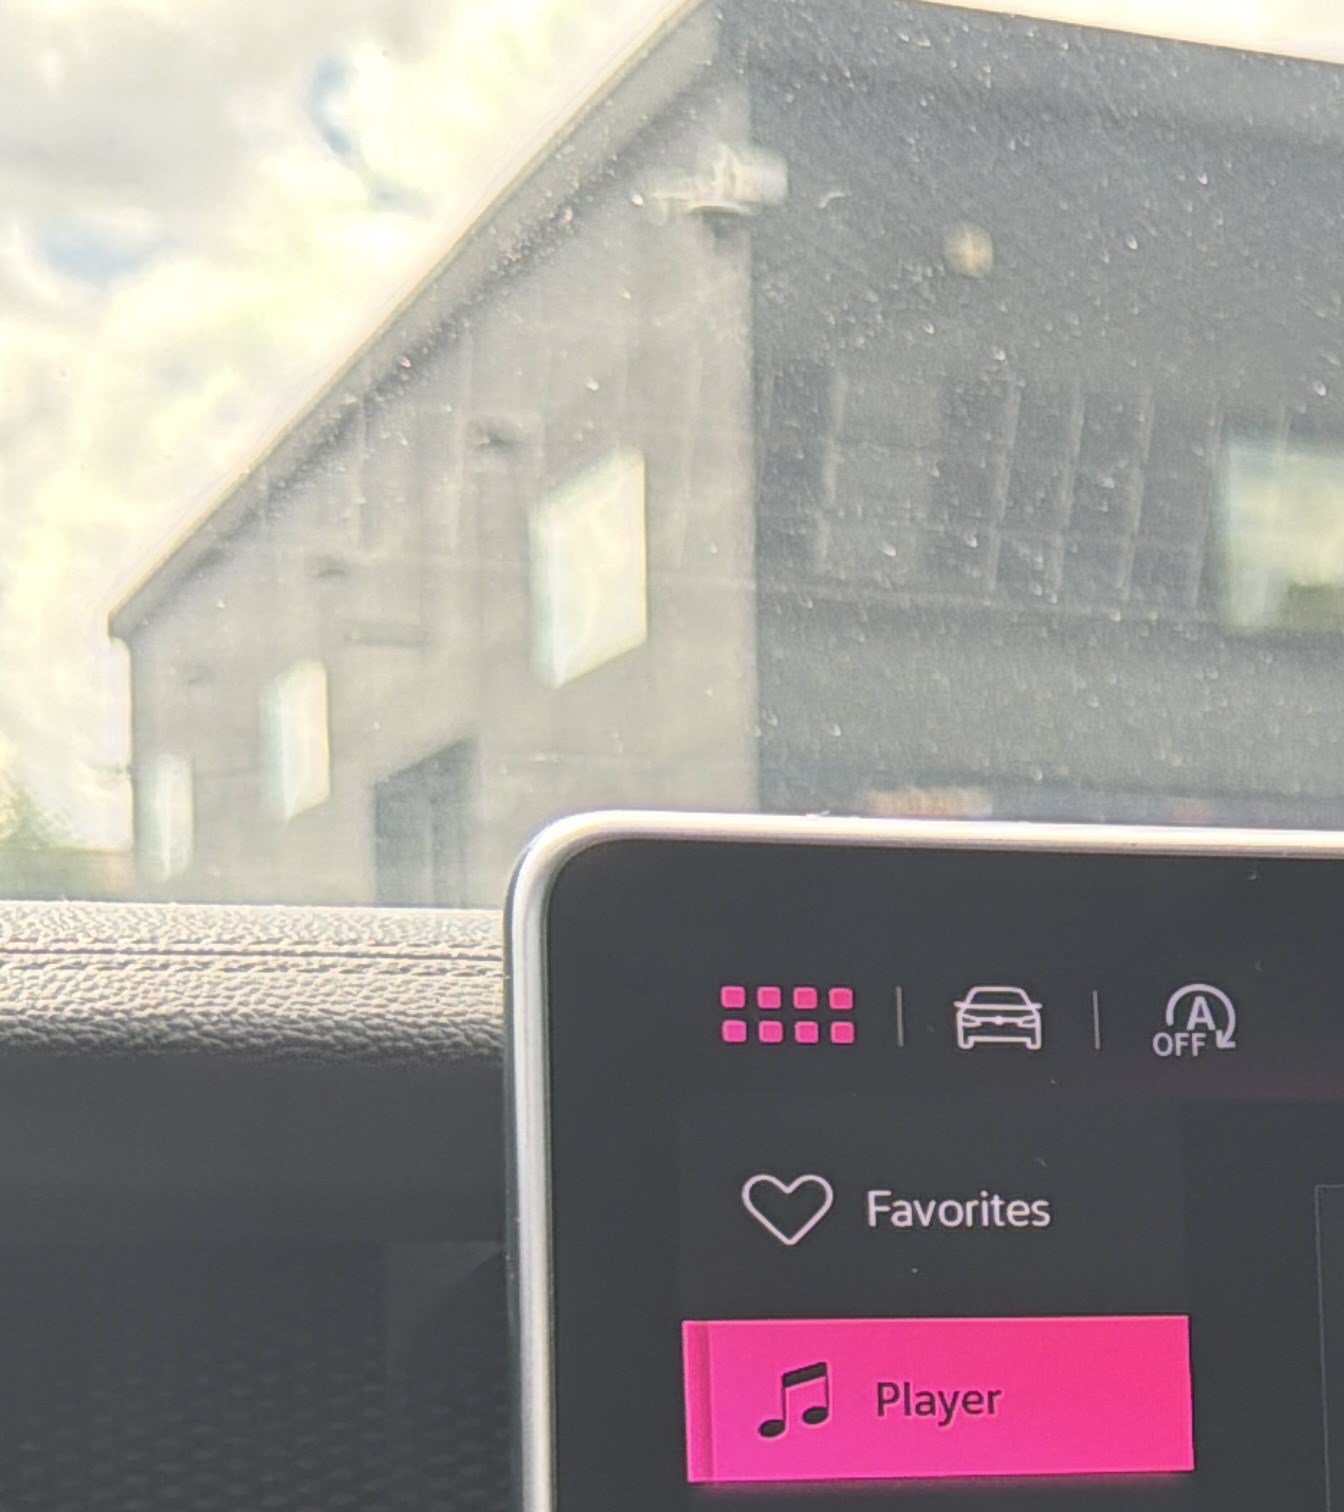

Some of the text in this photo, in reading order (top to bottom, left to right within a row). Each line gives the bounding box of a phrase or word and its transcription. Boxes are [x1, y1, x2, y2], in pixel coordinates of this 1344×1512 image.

[1186, 995, 1216, 1031] A
[1152, 1032, 1207, 1057] OFF
[867, 1188, 1051, 1228] Favorites
[876, 1380, 1002, 1428] Player
